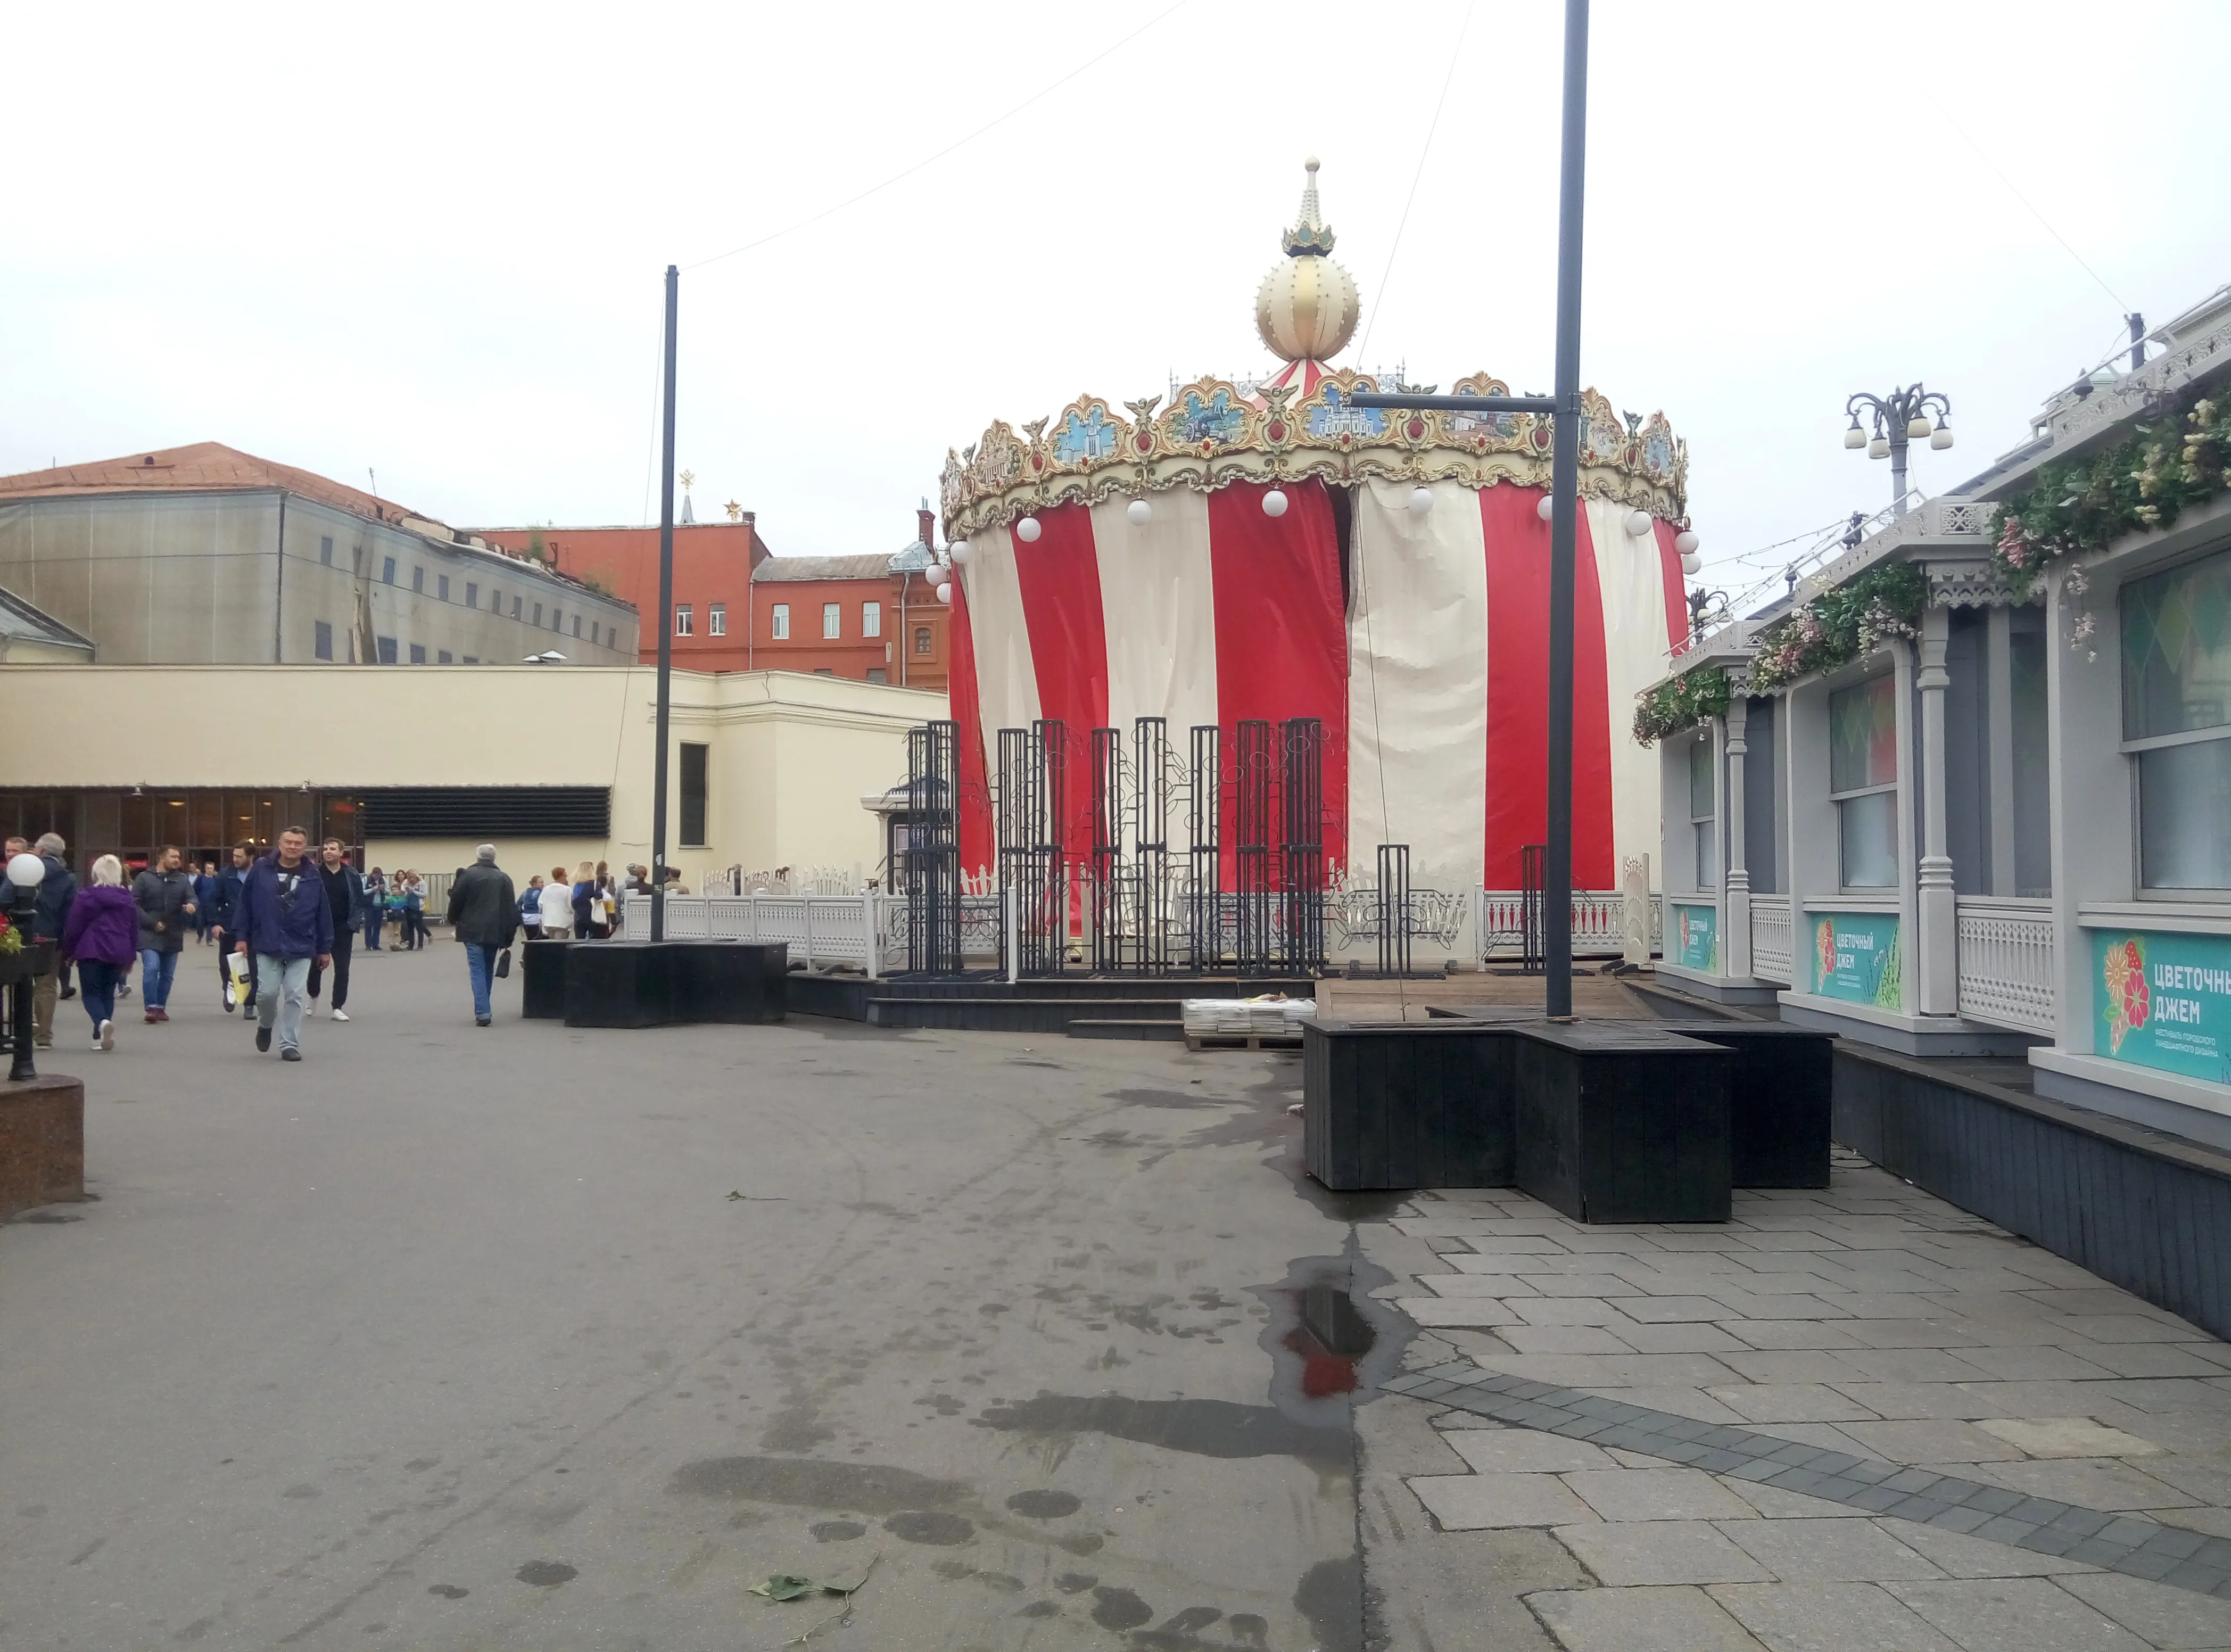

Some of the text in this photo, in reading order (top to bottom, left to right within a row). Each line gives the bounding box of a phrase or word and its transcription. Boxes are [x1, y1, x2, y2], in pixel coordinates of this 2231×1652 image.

[1837, 931, 1874, 951] ЦВЕТОЧНЫЙ
[1837, 953, 1855, 970] ДЖЕМ
[2154, 996, 2200, 1025] ДЖЕМ
